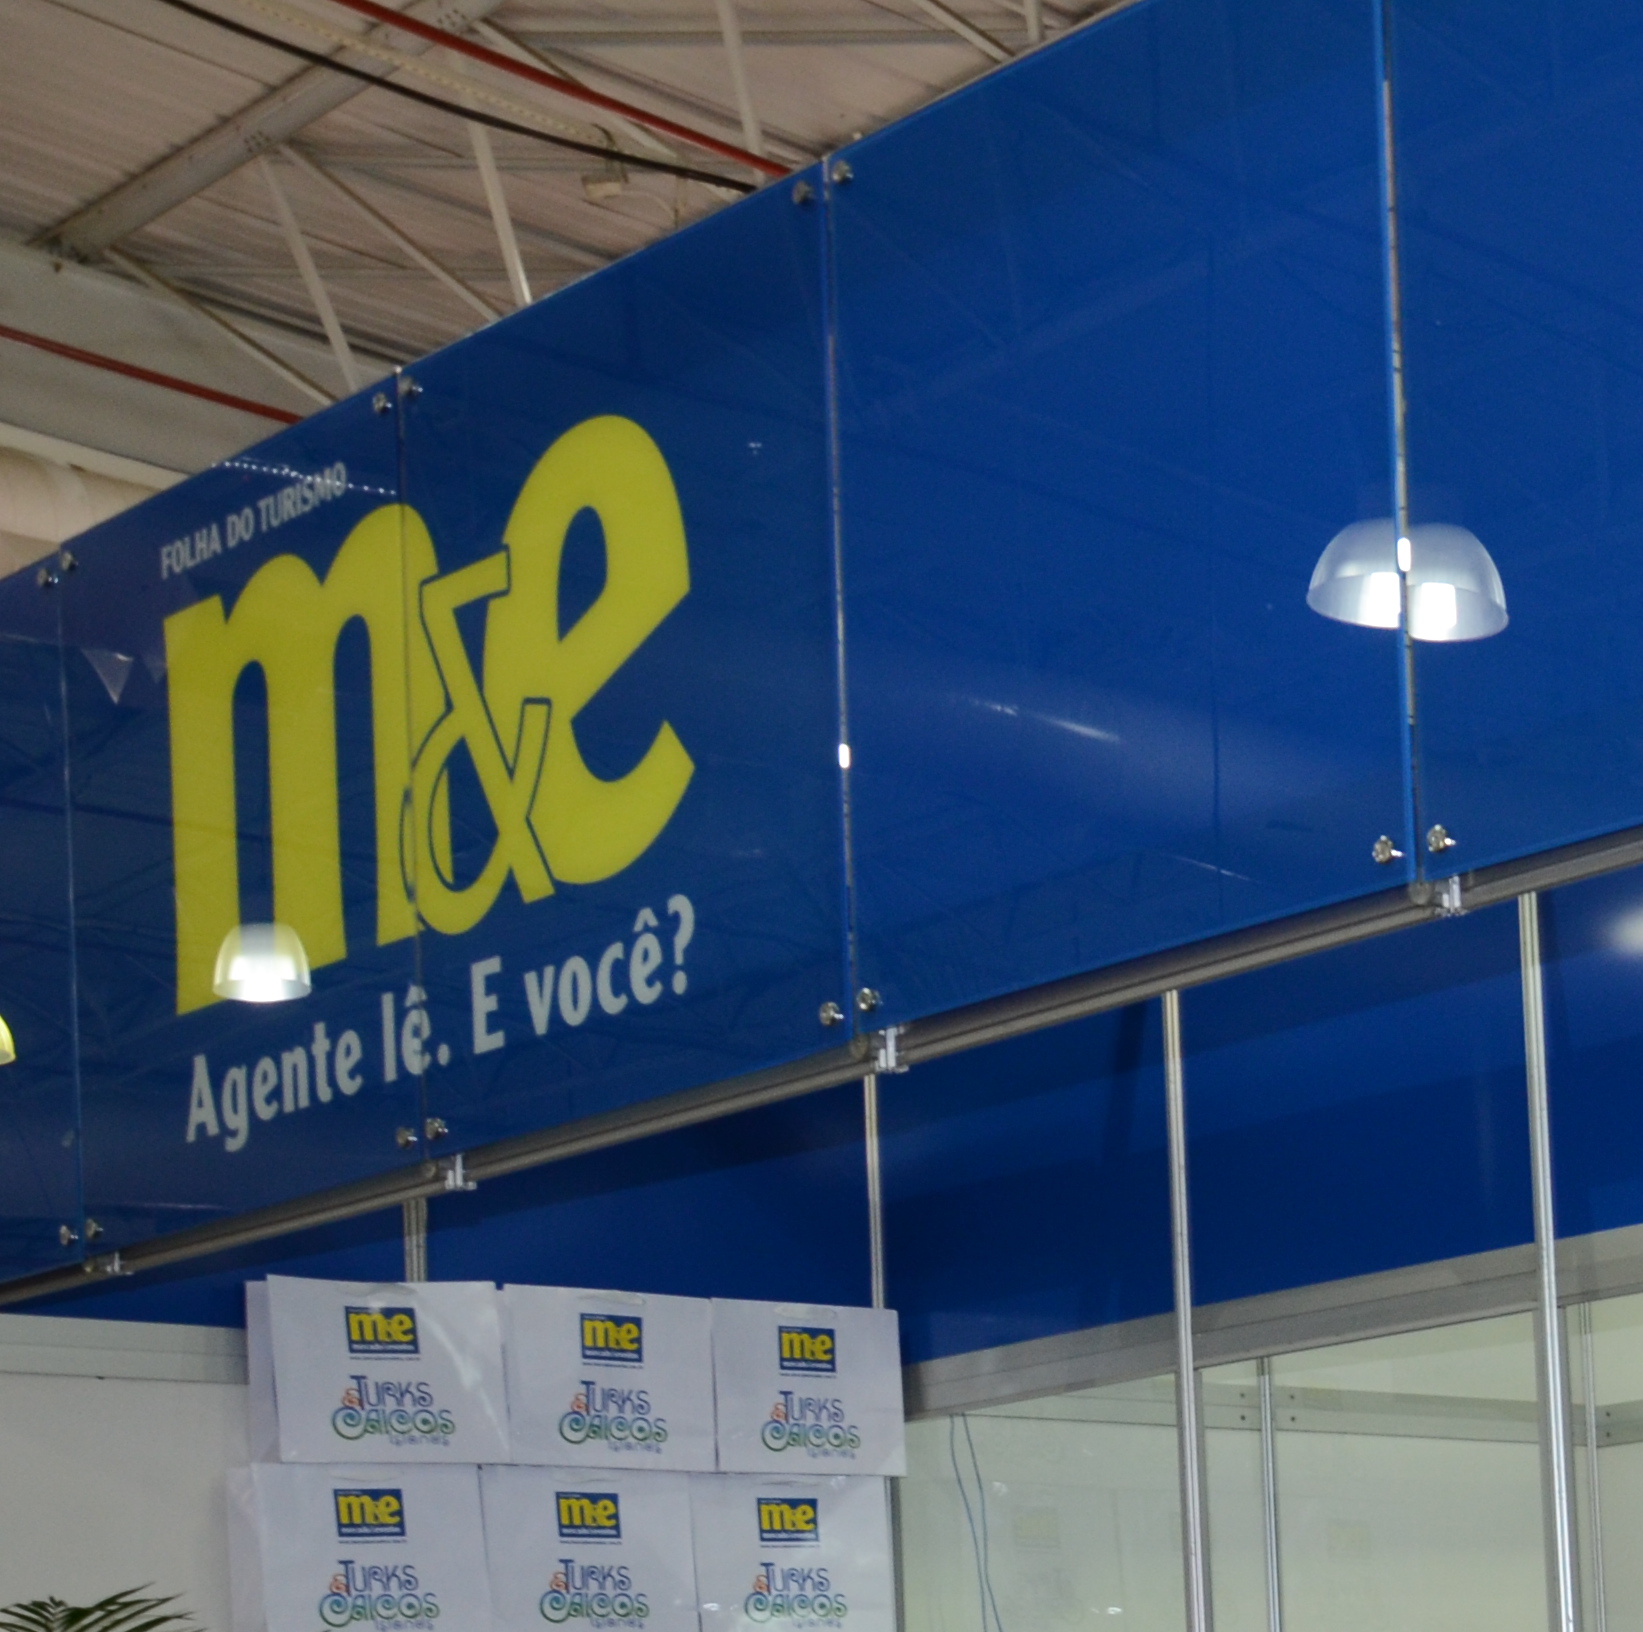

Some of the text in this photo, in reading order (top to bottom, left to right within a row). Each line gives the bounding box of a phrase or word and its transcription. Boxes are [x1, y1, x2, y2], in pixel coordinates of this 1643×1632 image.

[160, 461, 347, 580] FOLHA DO TURISMO
[163, 414, 696, 1016] m&e
[184, 1024, 363, 1152] Agente
[470, 954, 506, 1056] E
[524, 894, 696, 1037] você?
